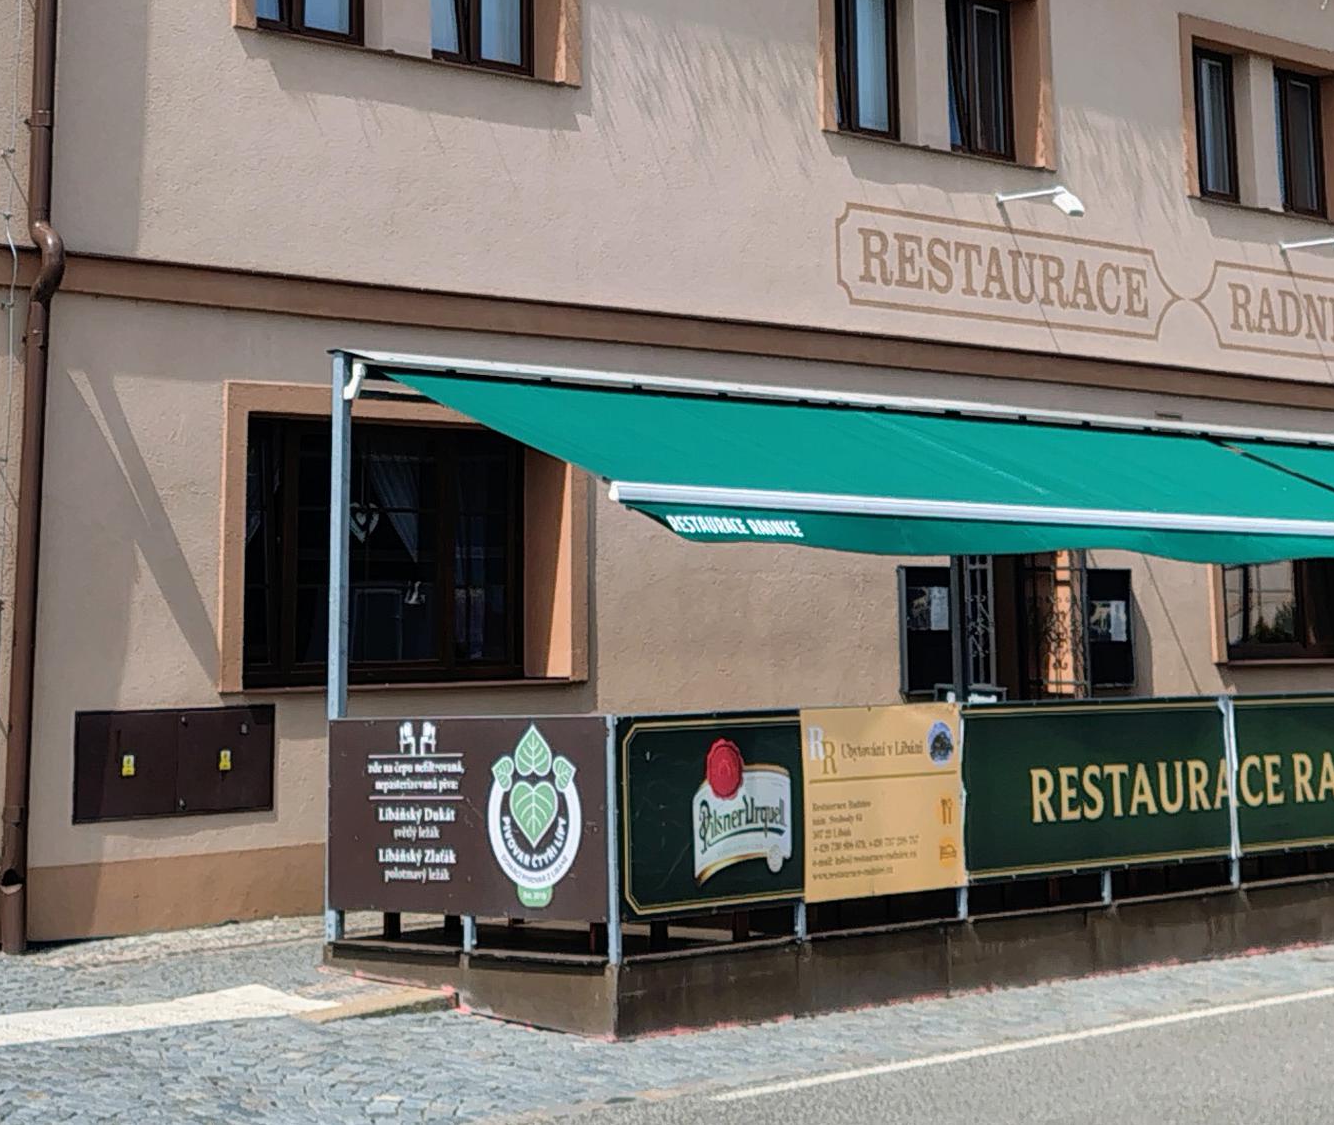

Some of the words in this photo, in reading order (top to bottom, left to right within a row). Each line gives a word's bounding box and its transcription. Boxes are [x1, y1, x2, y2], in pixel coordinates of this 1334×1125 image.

[858, 227, 1150, 318] RESTAURACE
[666, 514, 750, 535] RESTAURACE
[746, 518, 805, 538] RADNICE
[841, 741, 885, 762] Ubytování
[1030, 751, 1286, 824] RESTAURACE
[502, 816, 531, 868] PIVOVAR
[531, 845, 559, 868] ČTYŘI
[699, 799, 745, 855] Pilsner
[742, 794, 787, 838] Urquell
